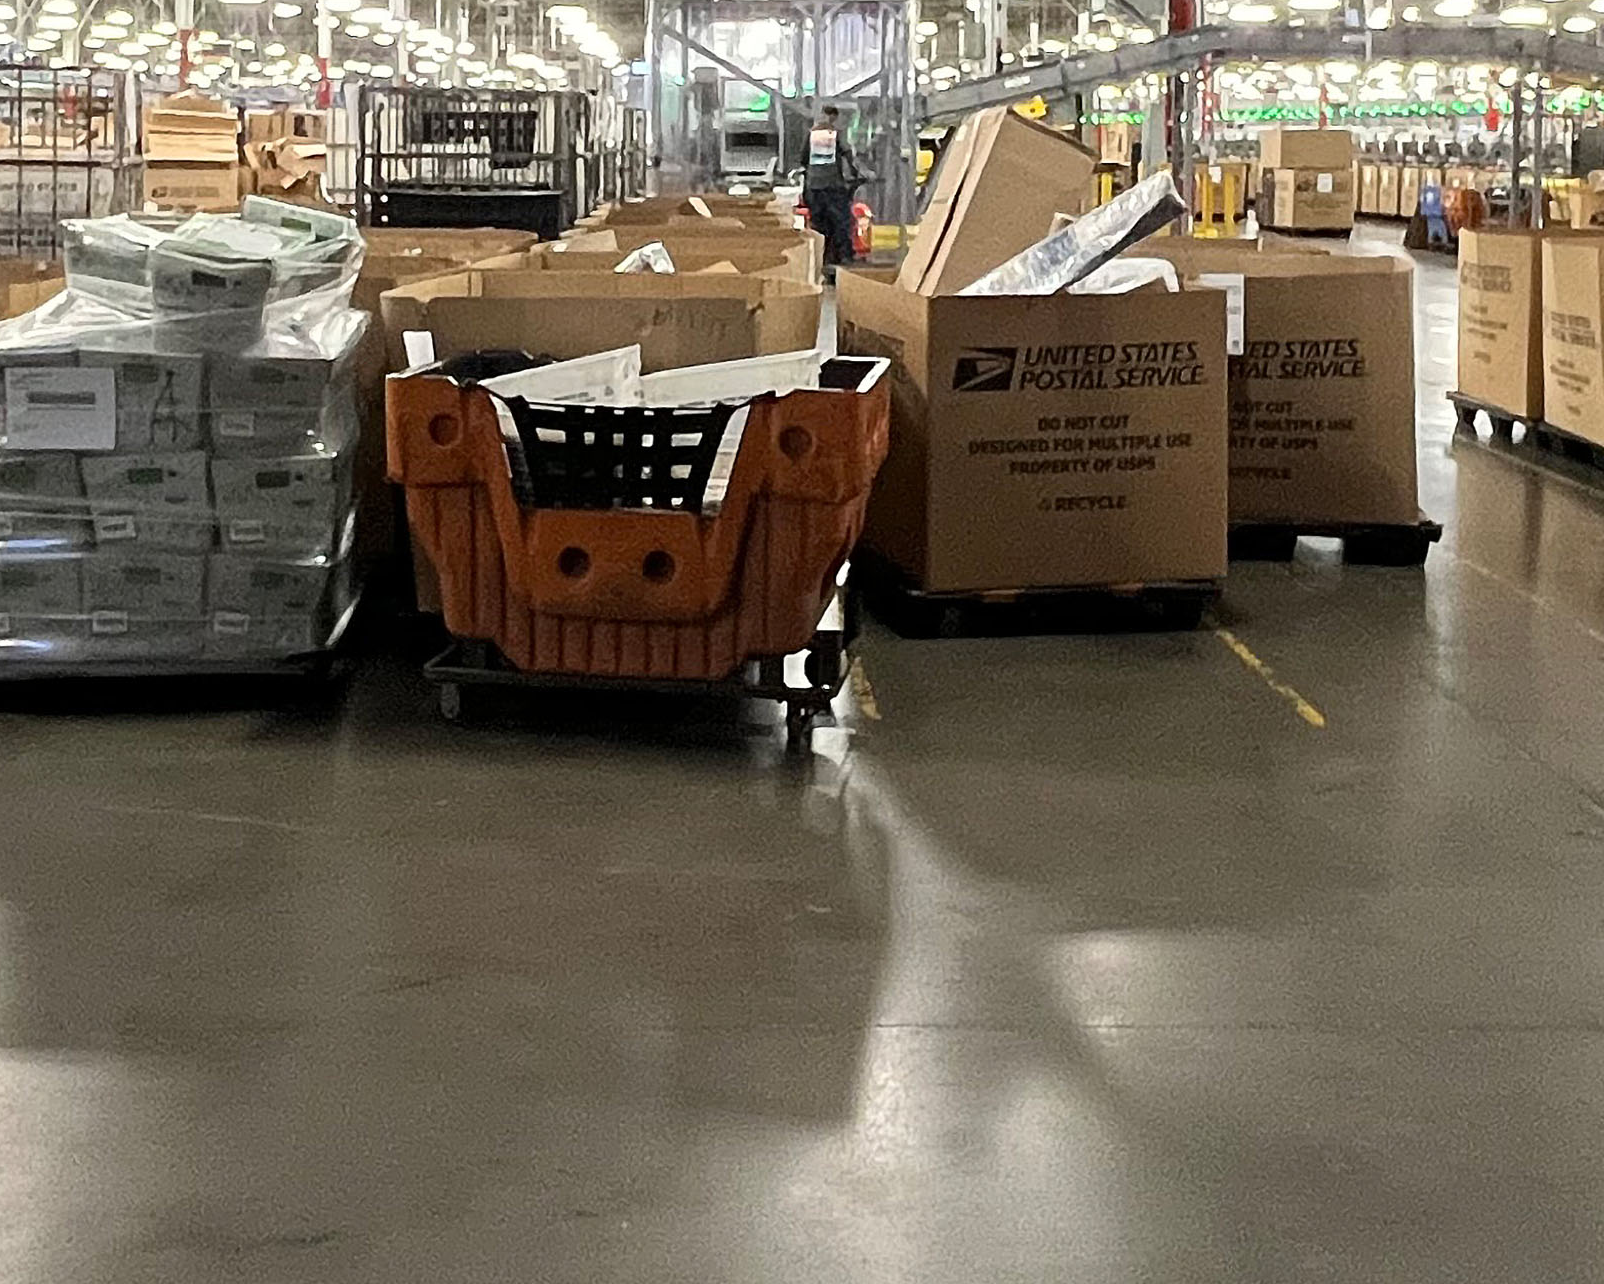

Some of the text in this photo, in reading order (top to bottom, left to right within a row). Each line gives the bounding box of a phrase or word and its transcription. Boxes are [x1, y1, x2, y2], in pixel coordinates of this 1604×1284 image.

[37, 182, 78, 192] STTES
[1024, 341, 1198, 367] UNITED STATES
[1283, 338, 1359, 359] STATES
[1277, 358, 1366, 379] SERVICE
[1019, 365, 1204, 392] POSTAL SERVICE
[1265, 401, 1294, 413] CUT
[1038, 415, 1130, 432] DO NOT CUT
[1230, 418, 1251, 431] OR
[968, 439, 1049, 456] DESIGNED
[1054, 438, 1085, 454] FOR
[1088, 435, 1162, 452] MULTIPLE
[1008, 459, 1089, 476] PROPERTY
[1093, 457, 1114, 473] OF
[1229, 467, 1291, 480] ECYCLE
[1055, 495, 1127, 512] RECYCLE
